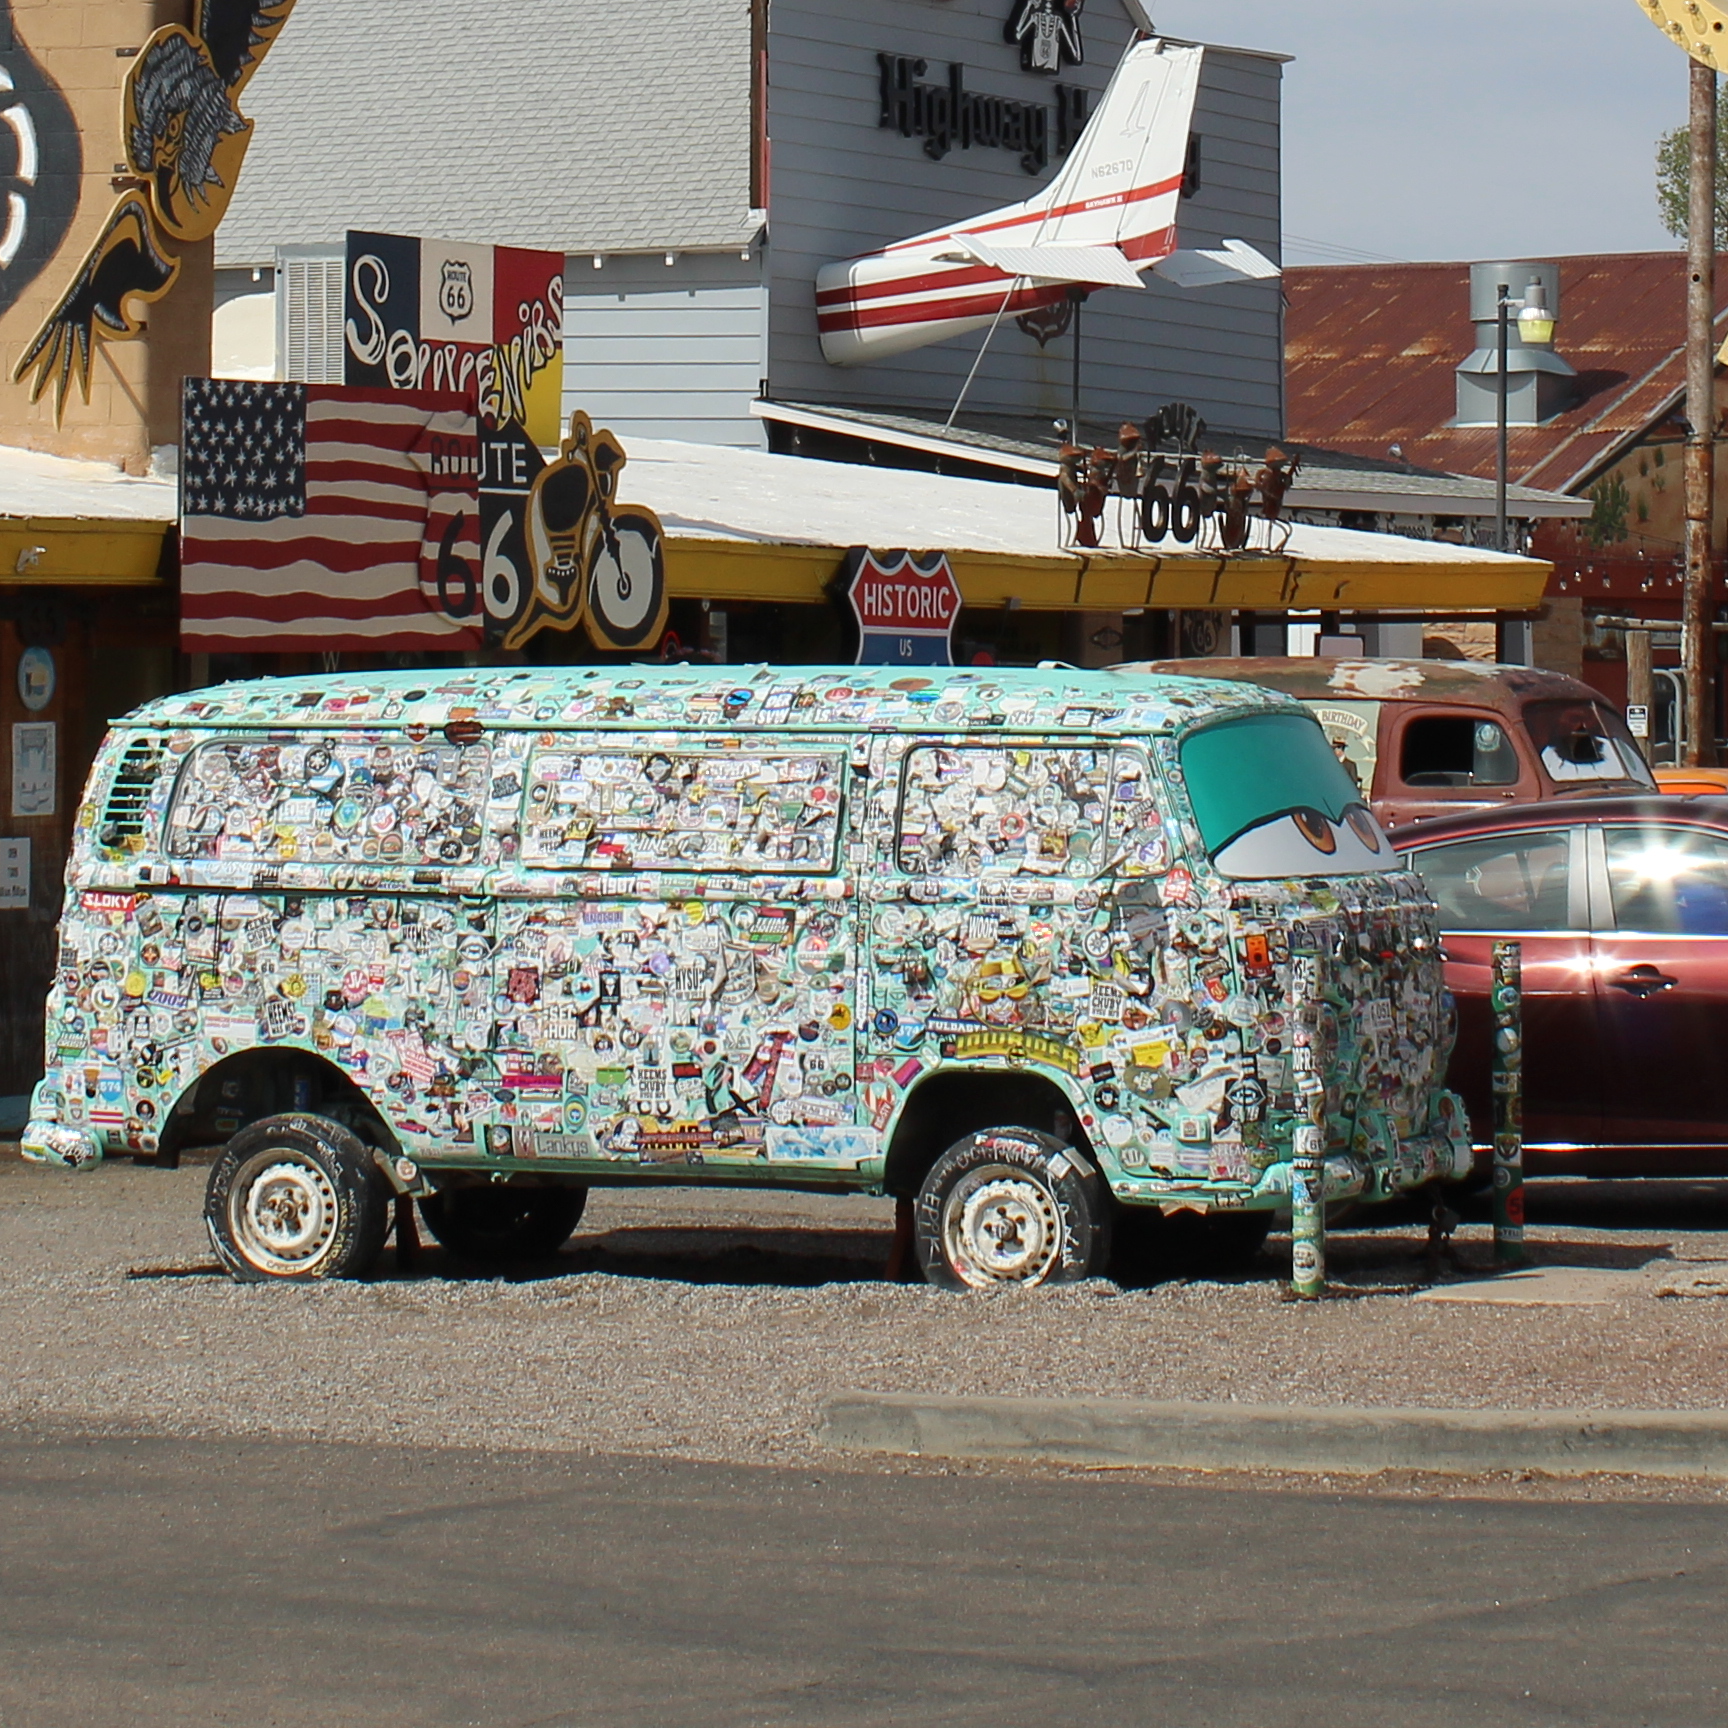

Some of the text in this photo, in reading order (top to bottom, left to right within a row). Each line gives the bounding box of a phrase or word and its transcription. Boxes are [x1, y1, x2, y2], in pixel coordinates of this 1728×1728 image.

[876, 52, 1048, 176] Highway
[447, 286, 466, 310] 66
[431, 435, 528, 485] ROUTE
[1142, 456, 1201, 544] 66
[437, 509, 520, 620] 66
[863, 582, 950, 619] HISTORIC
[899, 638, 912, 657] US
[1321, 711, 1366, 731] BIRTHDAY
[83, 895, 134, 908] SLOKY
[537, 1134, 590, 1156] Lankys
